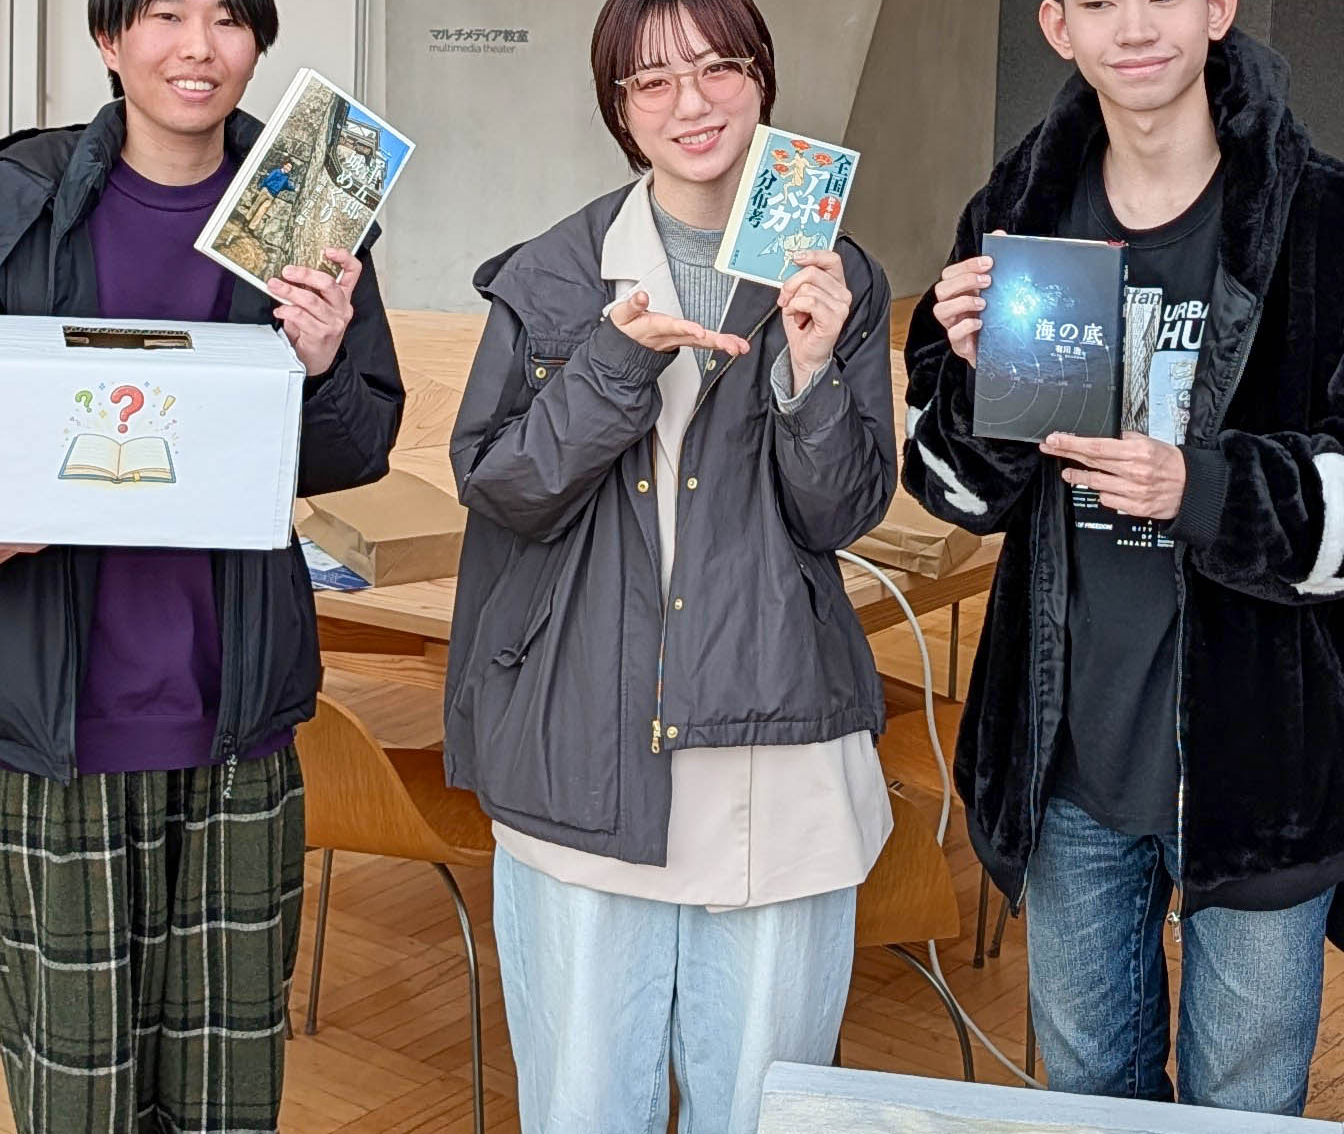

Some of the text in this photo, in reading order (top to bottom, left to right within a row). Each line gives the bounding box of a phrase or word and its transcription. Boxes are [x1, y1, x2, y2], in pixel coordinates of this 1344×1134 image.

[429, 29, 529, 43] マルチメディア教室
[429, 44, 481, 53] multimedia
[825, 153, 852, 198] 全国
[1034, 318, 1104, 346] 海の底
